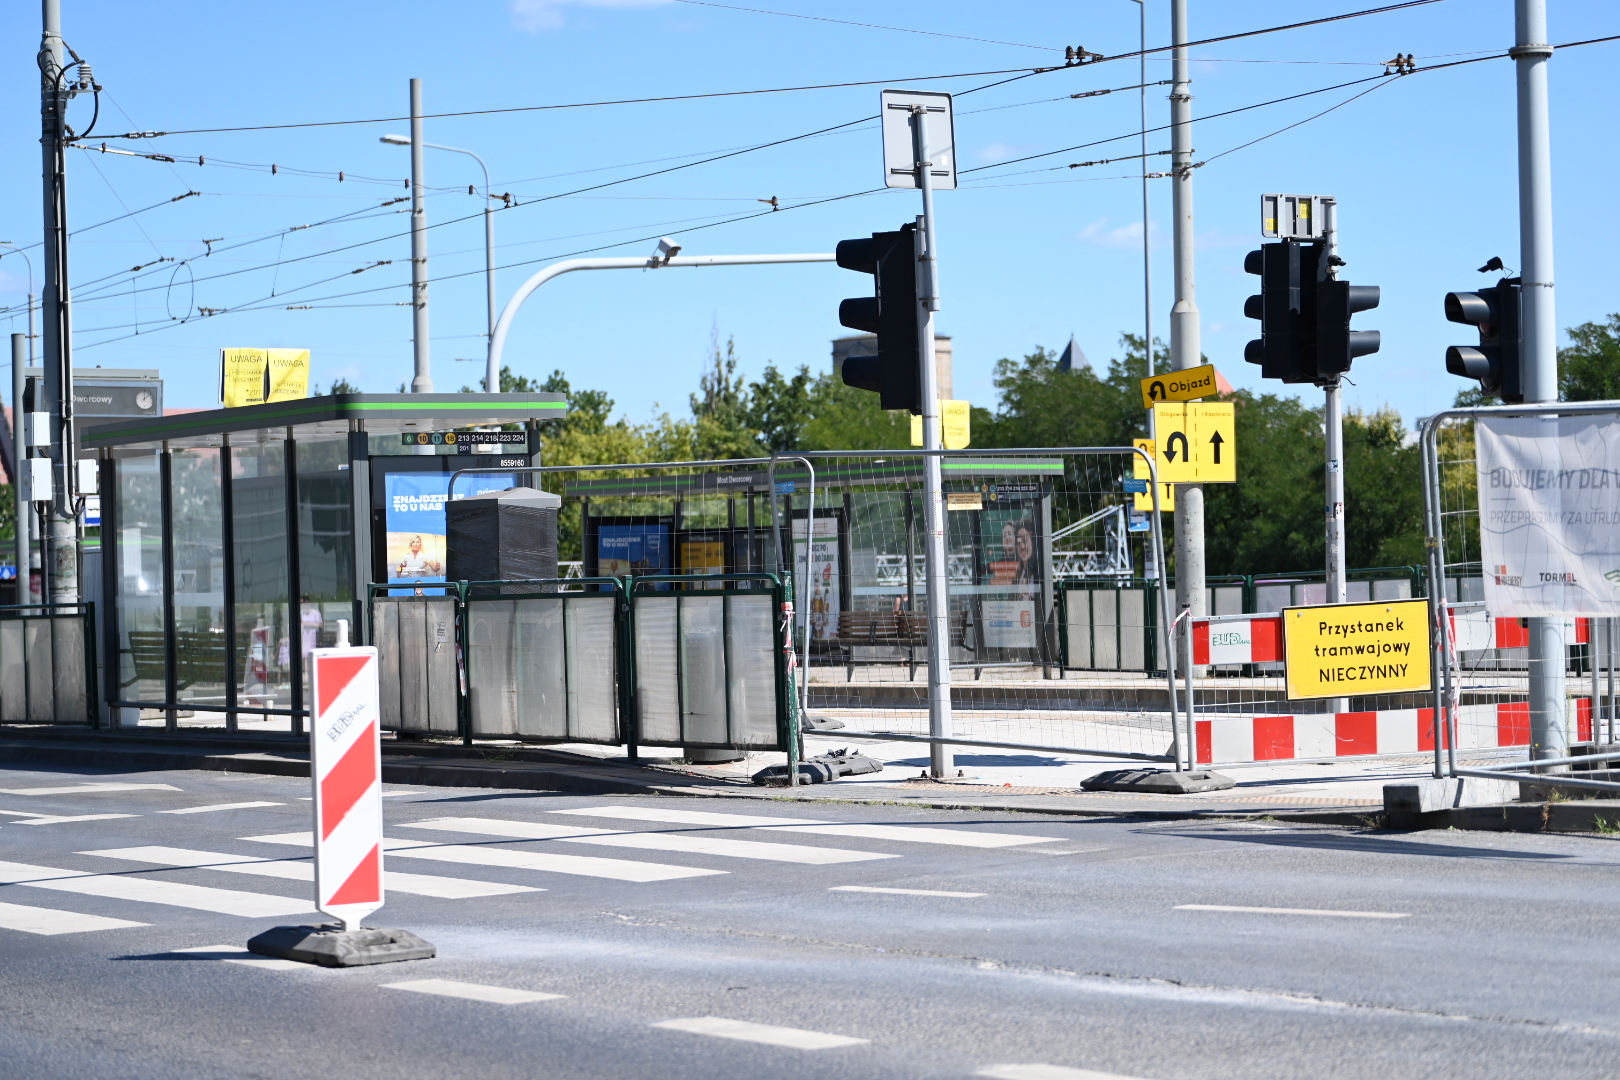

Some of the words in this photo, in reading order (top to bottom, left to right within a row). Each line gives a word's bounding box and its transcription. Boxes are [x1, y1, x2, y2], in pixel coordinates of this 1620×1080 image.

[231, 355, 263, 363] UWAGA
[273, 359, 305, 367] UWAGA
[1169, 375, 1211, 393] Objazd
[73, 395, 113, 404] Dworcowy
[457, 434, 470, 442] 213
[471, 434, 484, 442] 214
[485, 434, 497, 442] 218
[499, 434, 512, 442] 223
[512, 434, 524, 442] 224
[500, 459, 525, 467] 8559160
[716, 476, 728, 484] Most
[728, 475, 753, 483] Dworcowy
[1490, 468, 1575, 490] BUDUJEMY
[1579, 468, 1610, 490] DLA
[393, 503, 408, 512] TO
[409, 503, 418, 512] U
[419, 502, 443, 512] NAS
[1490, 510, 1566, 524] PRZEPRASZAMY
[1567, 510, 1582, 525] ZA
[1539, 572, 1577, 582] TORMEL
[1319, 616, 1405, 638] Przystanek
[1314, 639, 1410, 658] tramwajowy
[1319, 663, 1409, 683] NIECZYNNY
